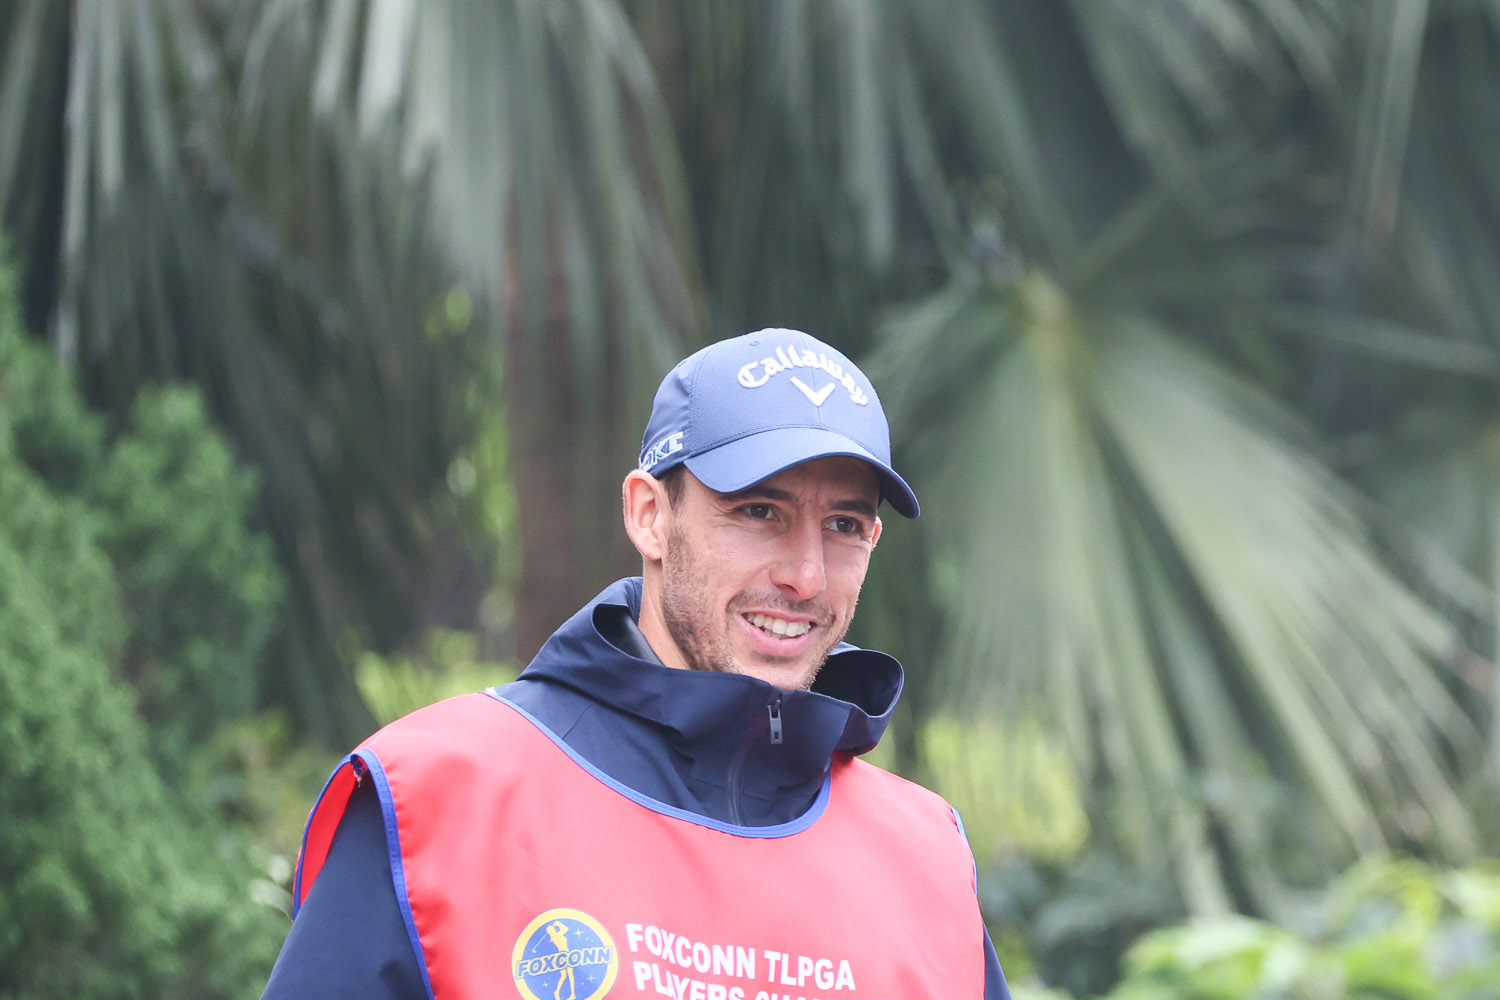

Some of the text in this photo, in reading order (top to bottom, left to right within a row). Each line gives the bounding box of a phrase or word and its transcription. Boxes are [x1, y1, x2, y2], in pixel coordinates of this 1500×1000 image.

[737, 345, 868, 406] Callaway
[515, 946, 613, 980] FOXCONN
[625, 923, 856, 991] FOXCONN TLPGA
